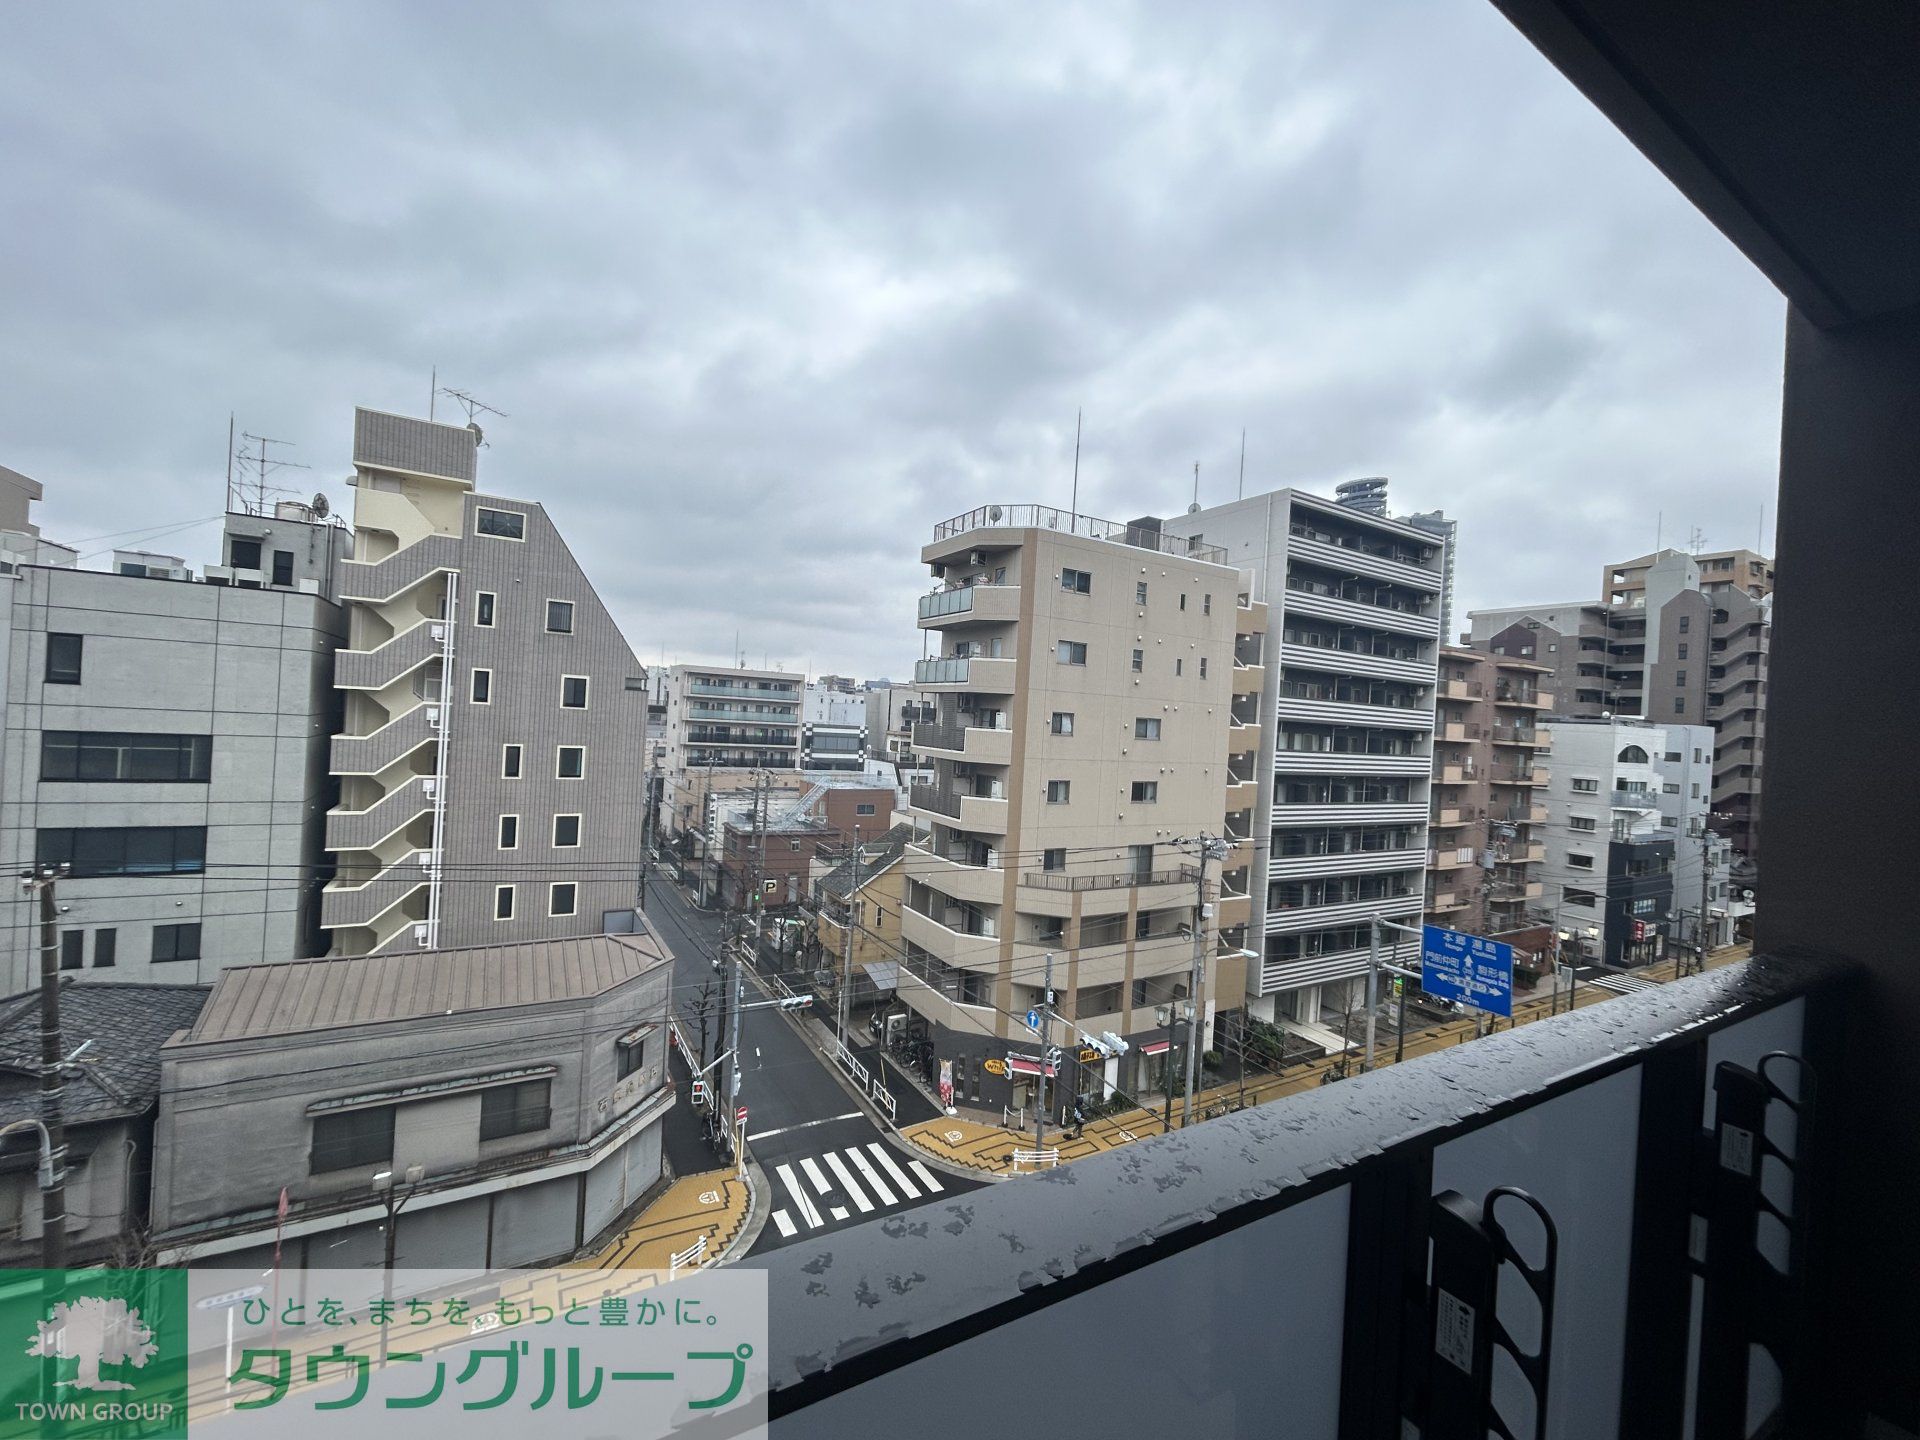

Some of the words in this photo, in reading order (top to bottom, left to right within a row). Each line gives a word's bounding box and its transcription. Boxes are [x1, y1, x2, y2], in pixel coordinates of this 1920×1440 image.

[766, 882, 776, 892] P
[1443, 933, 1466, 946] 本郷
[1425, 951, 1459, 968] 門前仲町
[1456, 993, 1480, 1006] 200m
